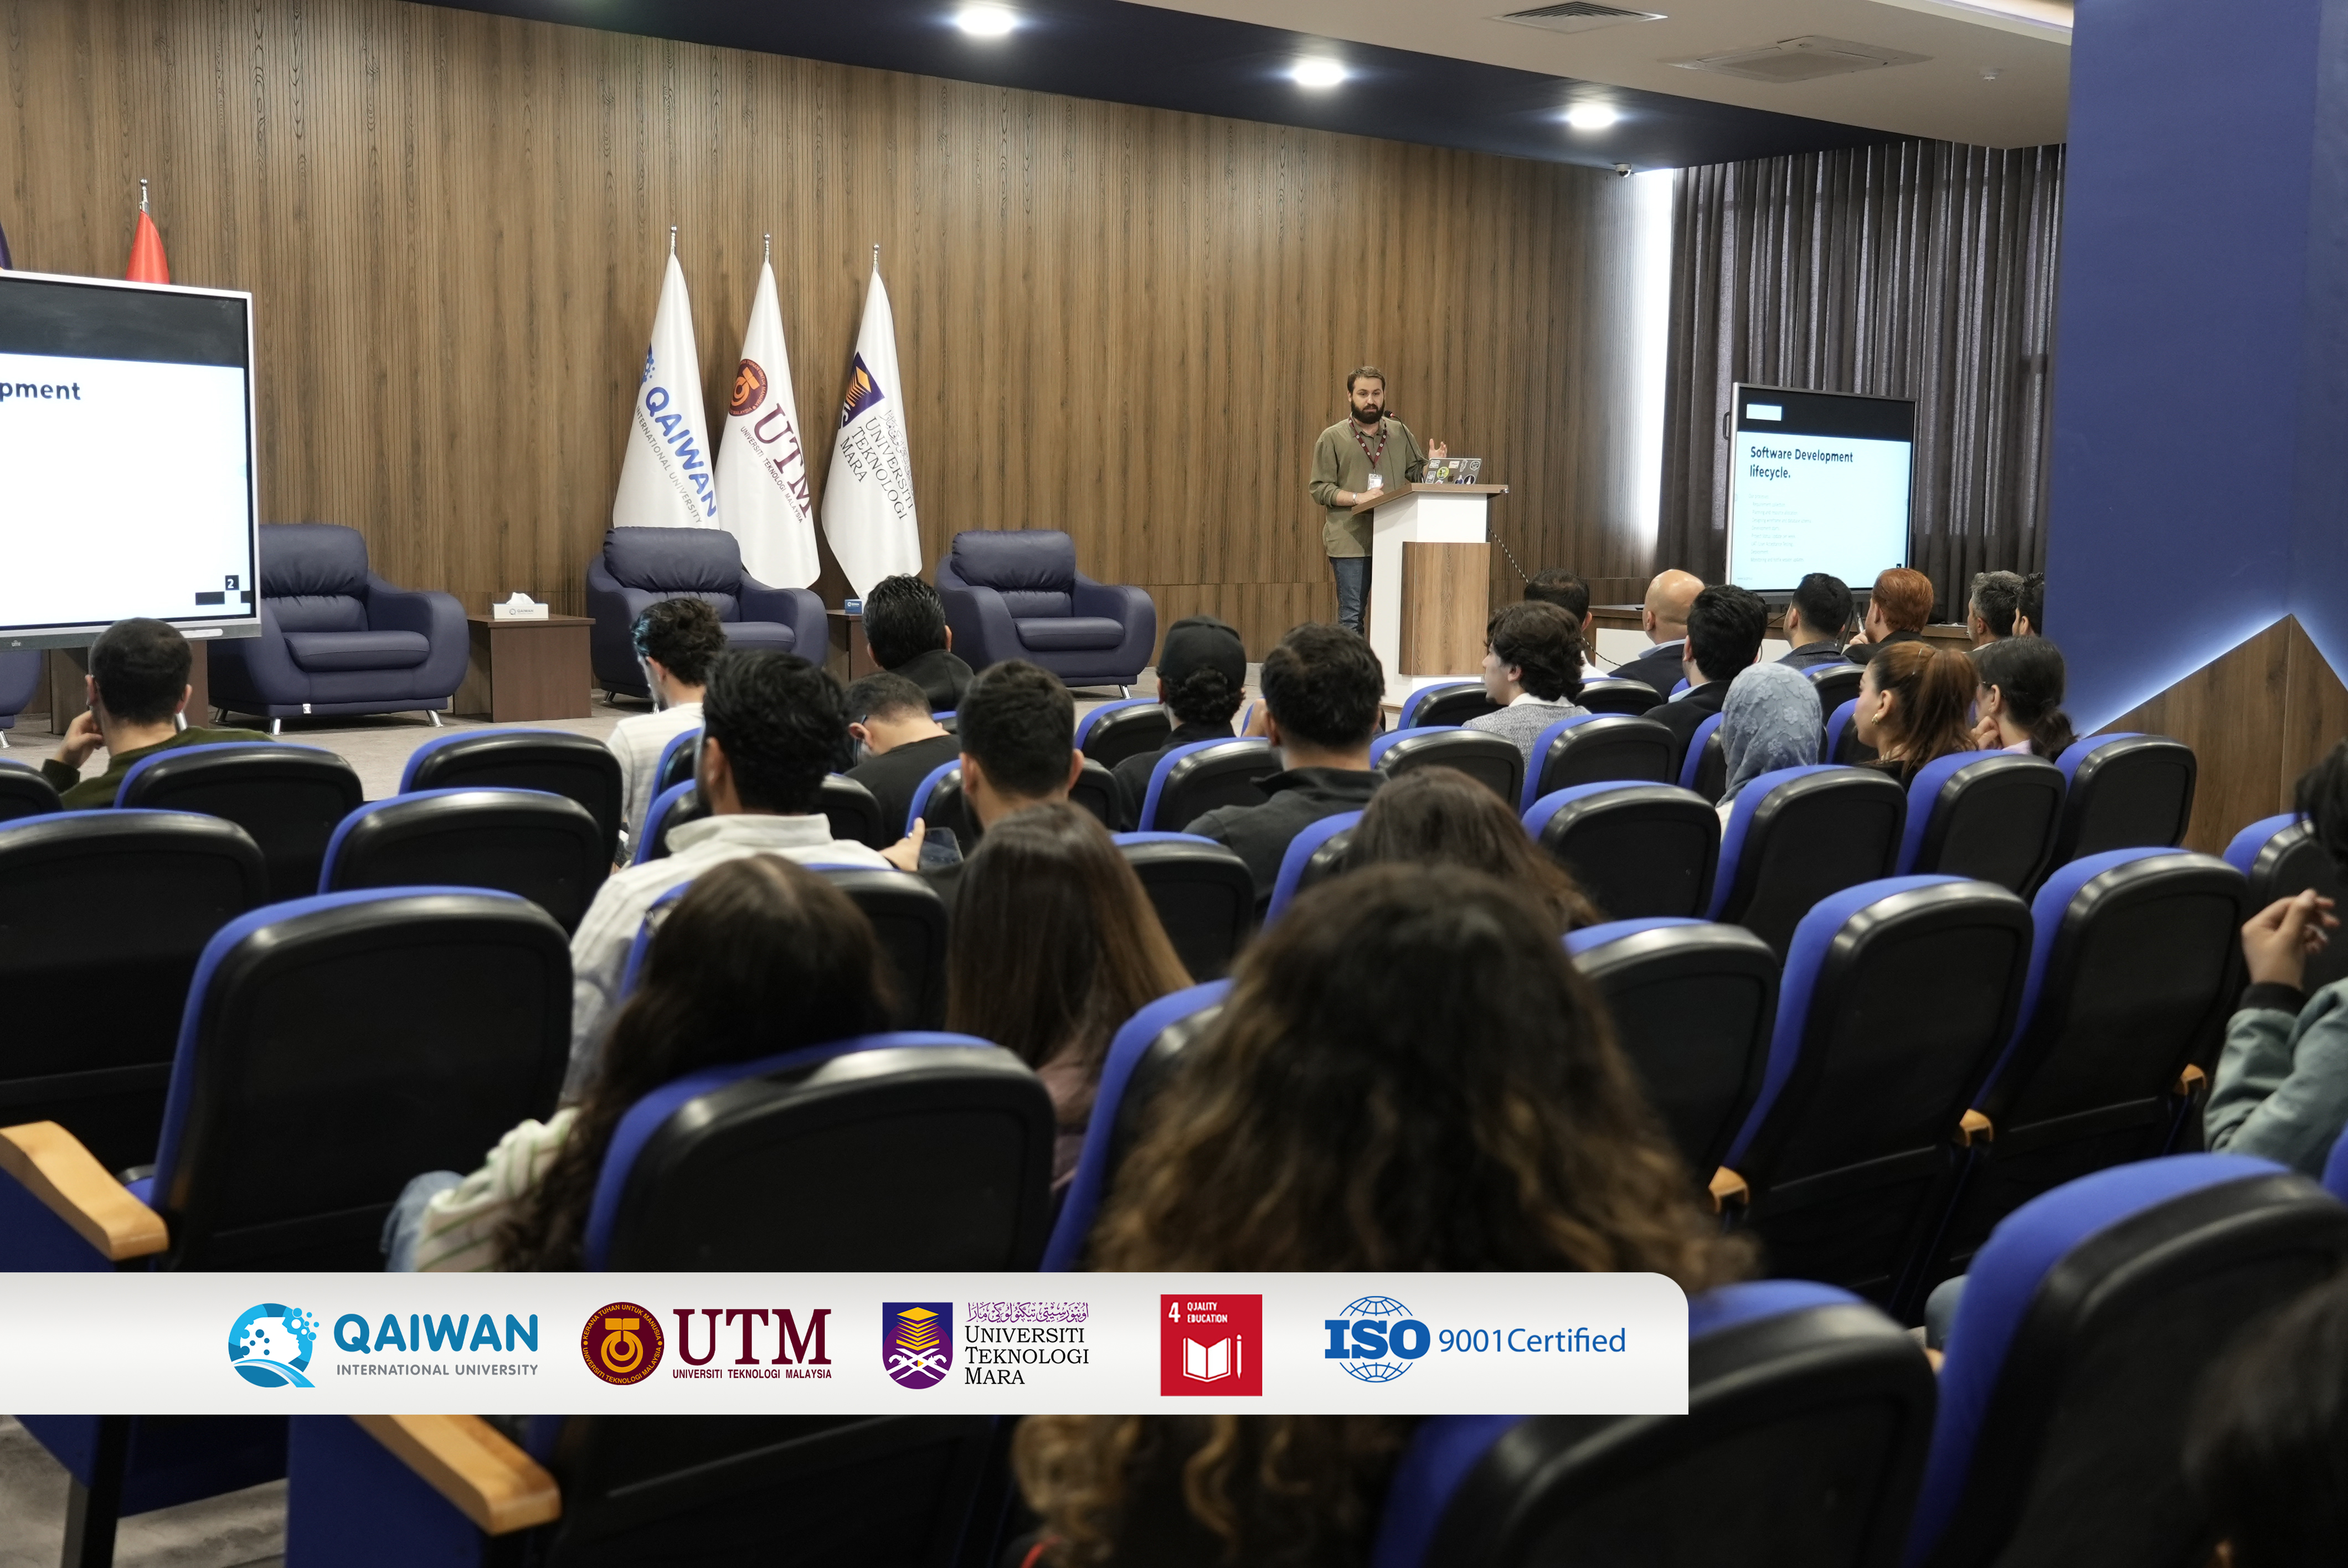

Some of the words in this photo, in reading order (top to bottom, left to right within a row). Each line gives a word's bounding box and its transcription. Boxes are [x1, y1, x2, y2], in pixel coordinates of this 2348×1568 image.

[636, 405, 671, 471] INTERNATIONAL
[669, 472, 702, 523] UNIVERSITY
[646, 386, 717, 517] QAIWAN
[740, 426, 764, 457] UNIVERSITI
[763, 457, 786, 492] TEKNOLOGI
[785, 493, 803, 524] MALAYSIA
[754, 403, 811, 519] UTM
[840, 436, 868, 483] MARA
[852, 426, 908, 520] TEKNOLOGI
[866, 416, 913, 509] UNIVERSITI
[1750, 446, 1792, 460] Software
[1795, 448, 1853, 464] Development
[1750, 464, 1790, 481] lifecycle.
[227, 579, 234, 589] 2
